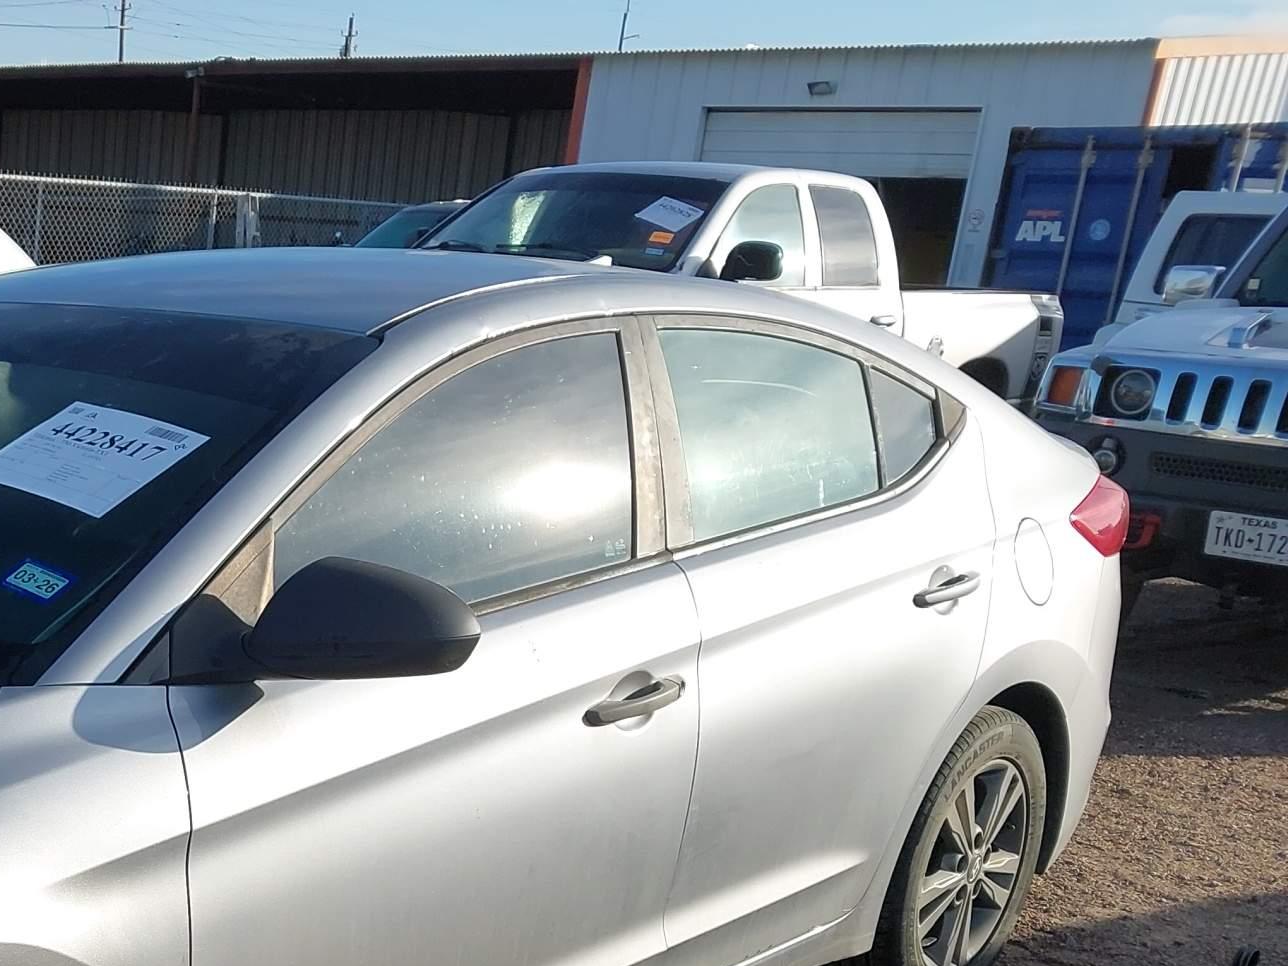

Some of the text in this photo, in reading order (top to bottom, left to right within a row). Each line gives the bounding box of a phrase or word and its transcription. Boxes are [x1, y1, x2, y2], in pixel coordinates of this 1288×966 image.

[1015, 220, 1065, 242] APL
[51, 422, 167, 461] 44228417
[1240, 516, 1279, 529] TEXAS
